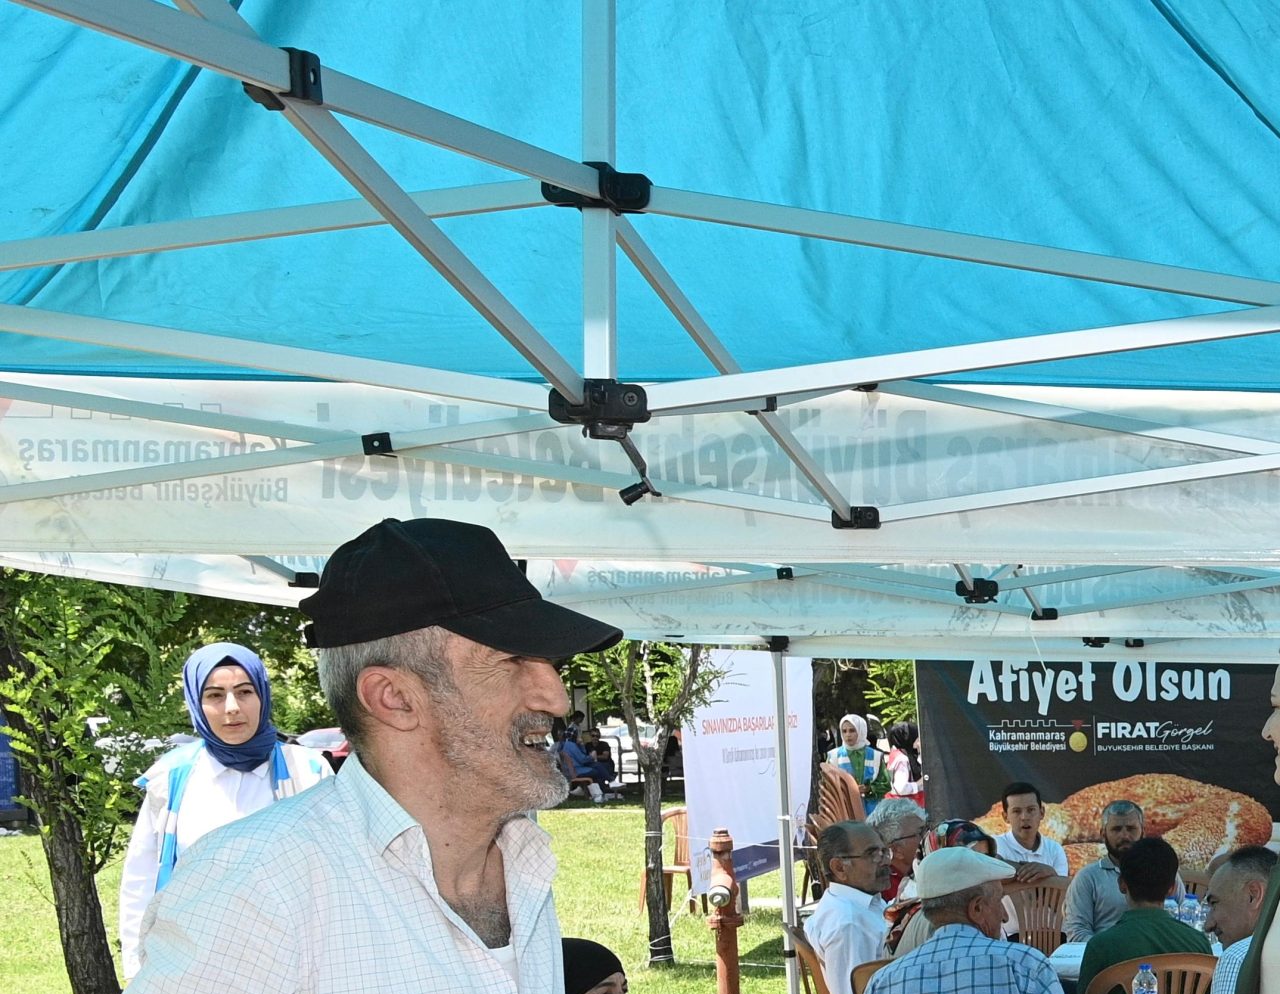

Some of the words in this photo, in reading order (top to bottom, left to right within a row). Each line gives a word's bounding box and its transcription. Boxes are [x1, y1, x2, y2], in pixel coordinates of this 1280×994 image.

[967, 660, 1096, 716] Afiyet
[1112, 661, 1231, 702] Olsun
[989, 730, 1066, 741] Kahramanmaraş
[1097, 722, 1160, 739] FIRAT
[1156, 720, 1214, 743] Görgel
[989, 741, 1029, 752] Büyükşehir
[1030, 741, 1067, 752] Belediyesi
